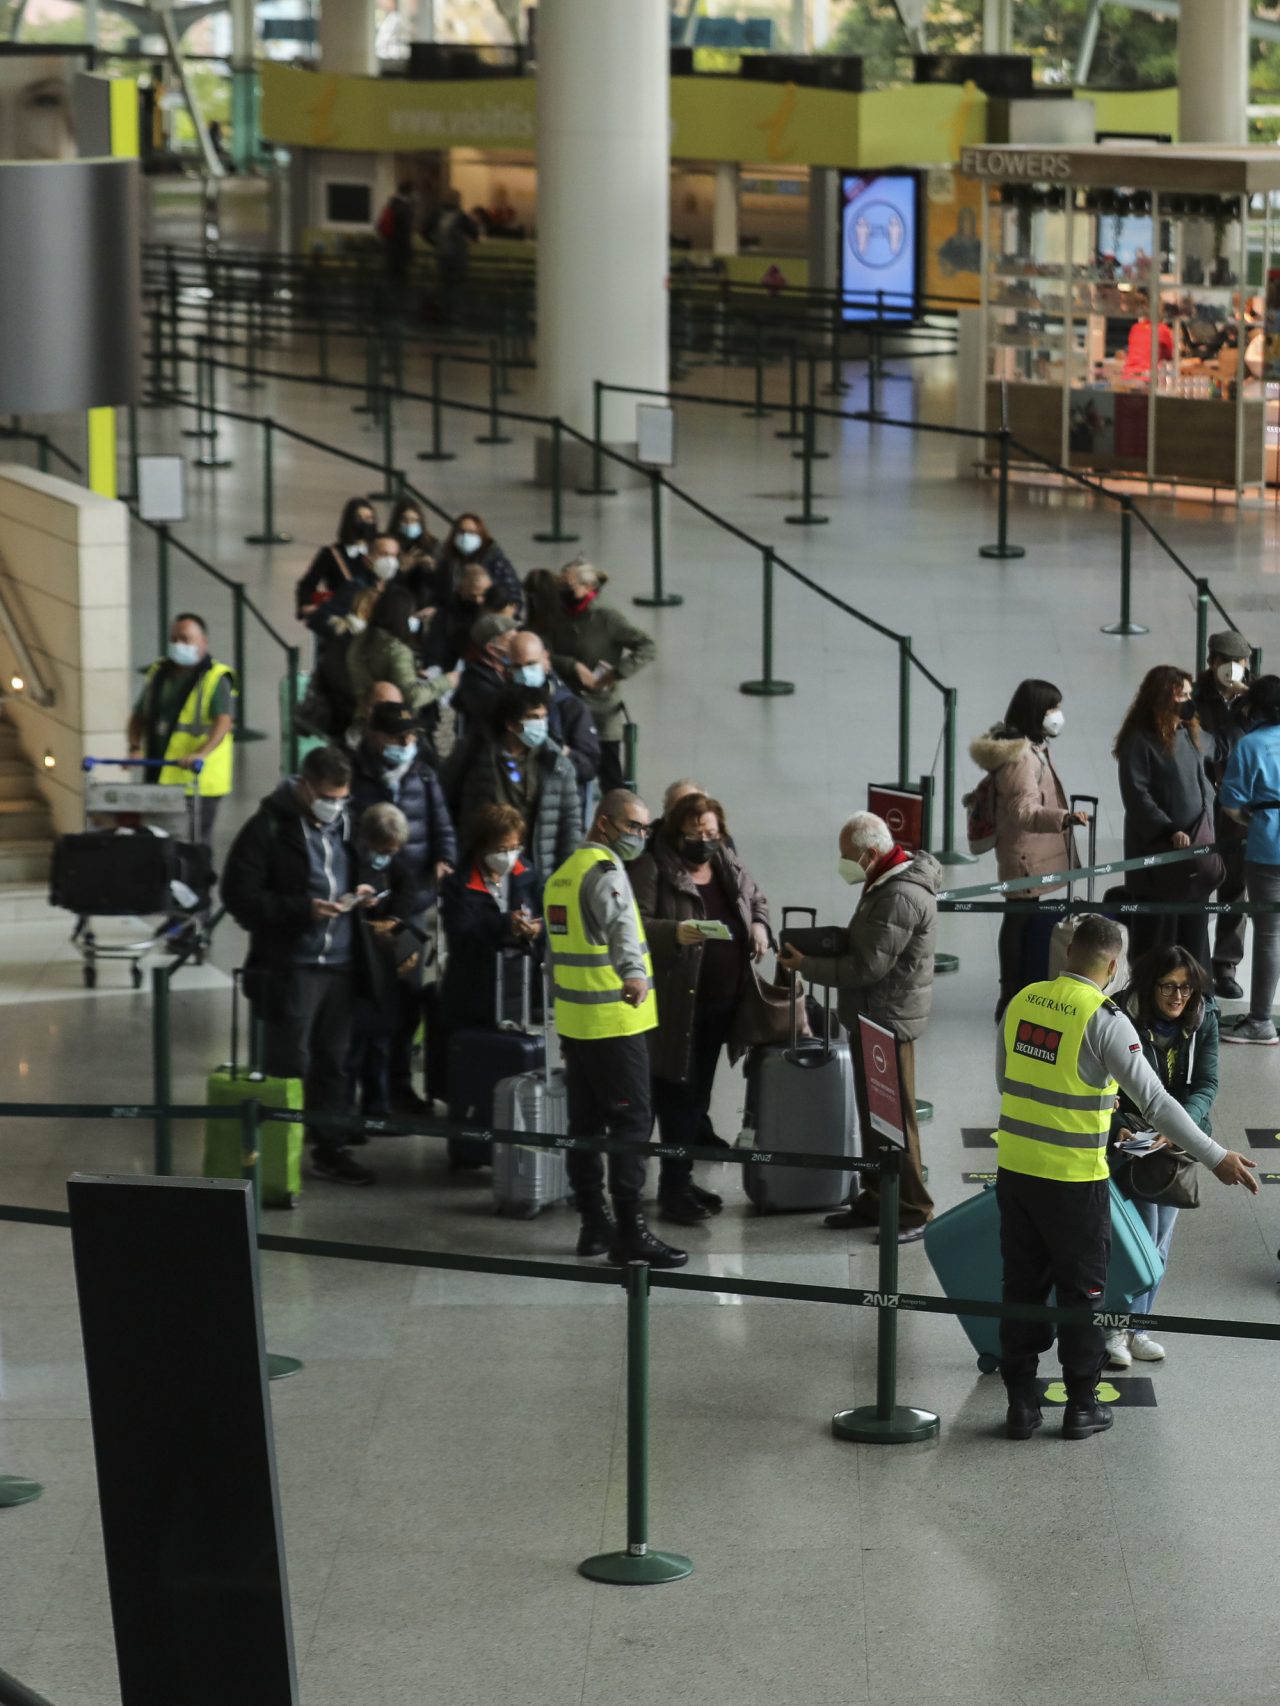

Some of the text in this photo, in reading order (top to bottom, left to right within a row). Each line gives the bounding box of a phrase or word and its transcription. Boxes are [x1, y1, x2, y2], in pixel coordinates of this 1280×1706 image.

[961, 150, 1071, 177] FLOWERS
[1026, 993, 1077, 1016] SEGURANÇA
[1016, 1042, 1056, 1062] SECURITAS
